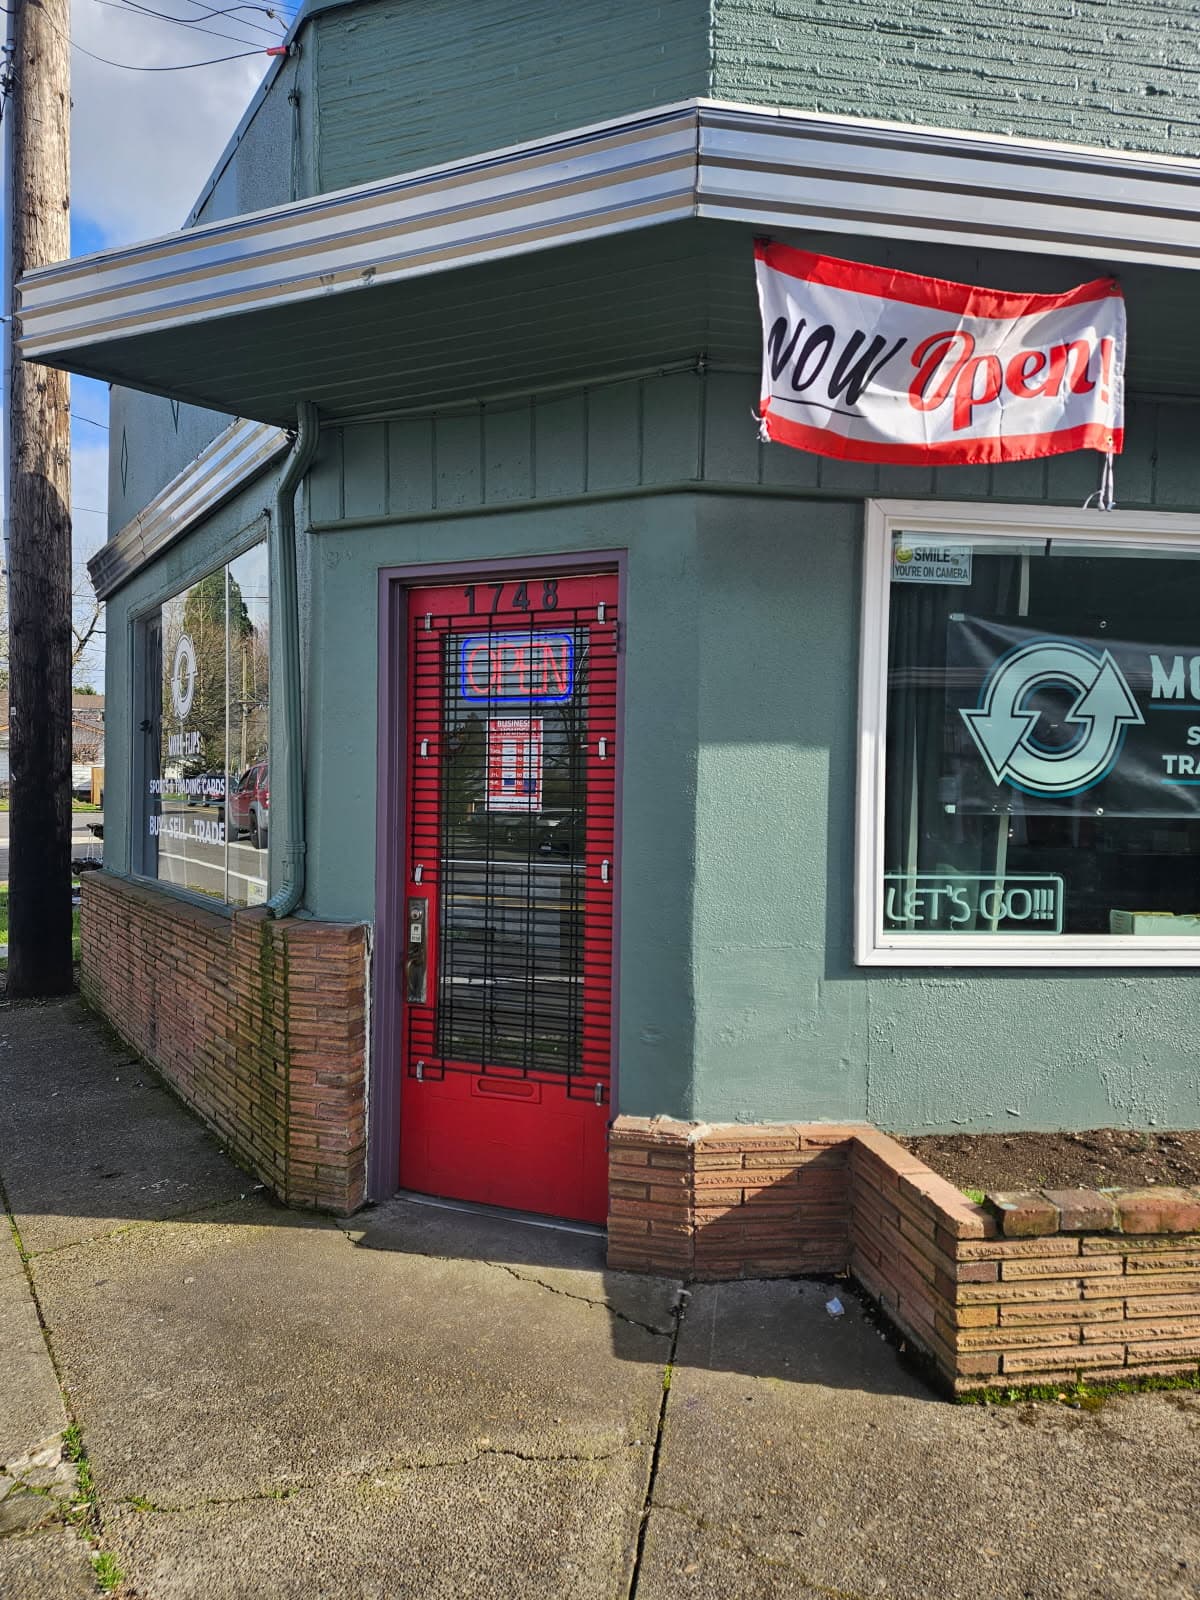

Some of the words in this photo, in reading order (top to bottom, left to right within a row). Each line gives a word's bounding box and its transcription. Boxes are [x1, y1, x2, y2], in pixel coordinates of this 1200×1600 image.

[767, 316, 908, 405] NOW
[908, 330, 1114, 431] Open!
[895, 565, 922, 577] YOU'RE
[923, 567, 935, 577] ON
[936, 567, 969, 579] CAMERA
[914, 547, 951, 563] SMILE
[463, 579, 559, 616] 1748
[467, 642, 568, 694] OPEN
[175, 779, 201, 793] TRADING
[202, 778, 225, 795] CARDS
[149, 815, 164, 837] BUY
[194, 819, 225, 847] TRADE
[886, 884, 971, 923] LET'S
[980, 888, 1054, 921] GO!!!
